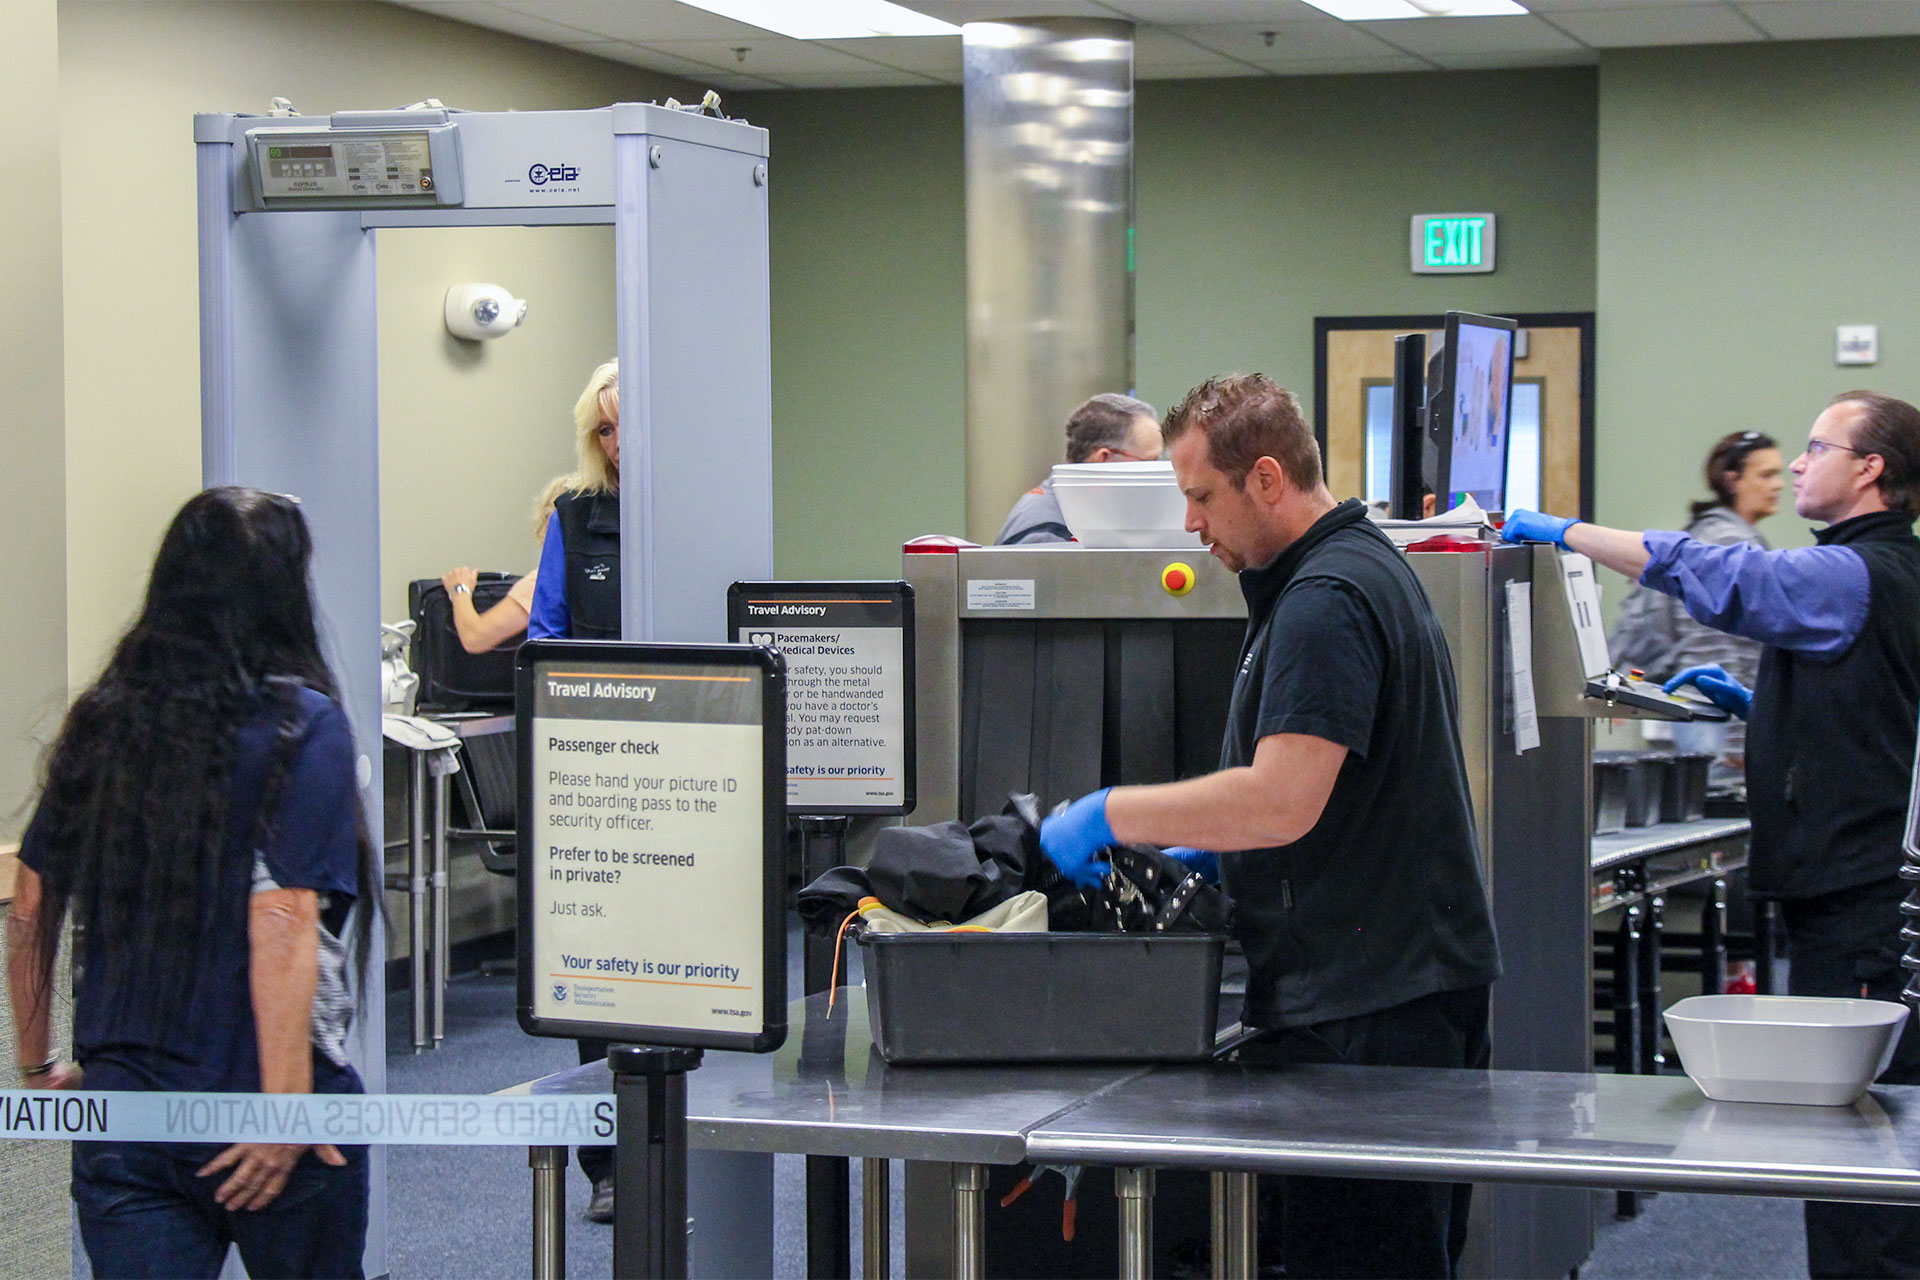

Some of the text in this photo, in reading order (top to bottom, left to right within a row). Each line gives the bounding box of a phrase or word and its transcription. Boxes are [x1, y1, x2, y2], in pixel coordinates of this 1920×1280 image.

[1425, 217, 1486, 266] EXIT
[748, 605, 827, 617] Travel Advisory
[777, 633, 841, 644] Pacemakers/
[778, 645, 855, 655] Medical Devices
[794, 665, 827, 676] safety,
[829, 667, 848, 677] you
[850, 665, 883, 675] should
[787, 677, 870, 688] hrough the metal
[548, 681, 657, 702] Travel Advisory
[793, 691, 804, 699] or
[806, 689, 819, 699] be
[822, 689, 884, 699] handwanded
[804, 701, 829, 711] have
[831, 703, 838, 711] a
[839, 701, 878, 711] doctor's
[798, 713, 817, 723] You
[819, 715, 841, 726] may
[843, 713, 880, 726] request
[786, 725, 852, 736] ody pat-down
[549, 737, 660, 755] Passenger check
[803, 739, 815, 747] as
[817, 739, 829, 747] an
[831, 737, 887, 747] alternative.
[817, 765, 826, 775] is
[828, 766, 845, 775] our
[847, 765, 886, 776] priority
[549, 771, 737, 793] Please hand your picture ID
[549, 793, 717, 813] and boarding pass to the
[549, 813, 654, 831] security officer.
[550, 846, 695, 867] Prefer to be screened
[550, 866, 621, 884] in private?
[549, 900, 607, 918] Just ask.
[561, 954, 740, 982] Your safety is our priority
[711, 1006, 753, 1018] www.tsa.gov
